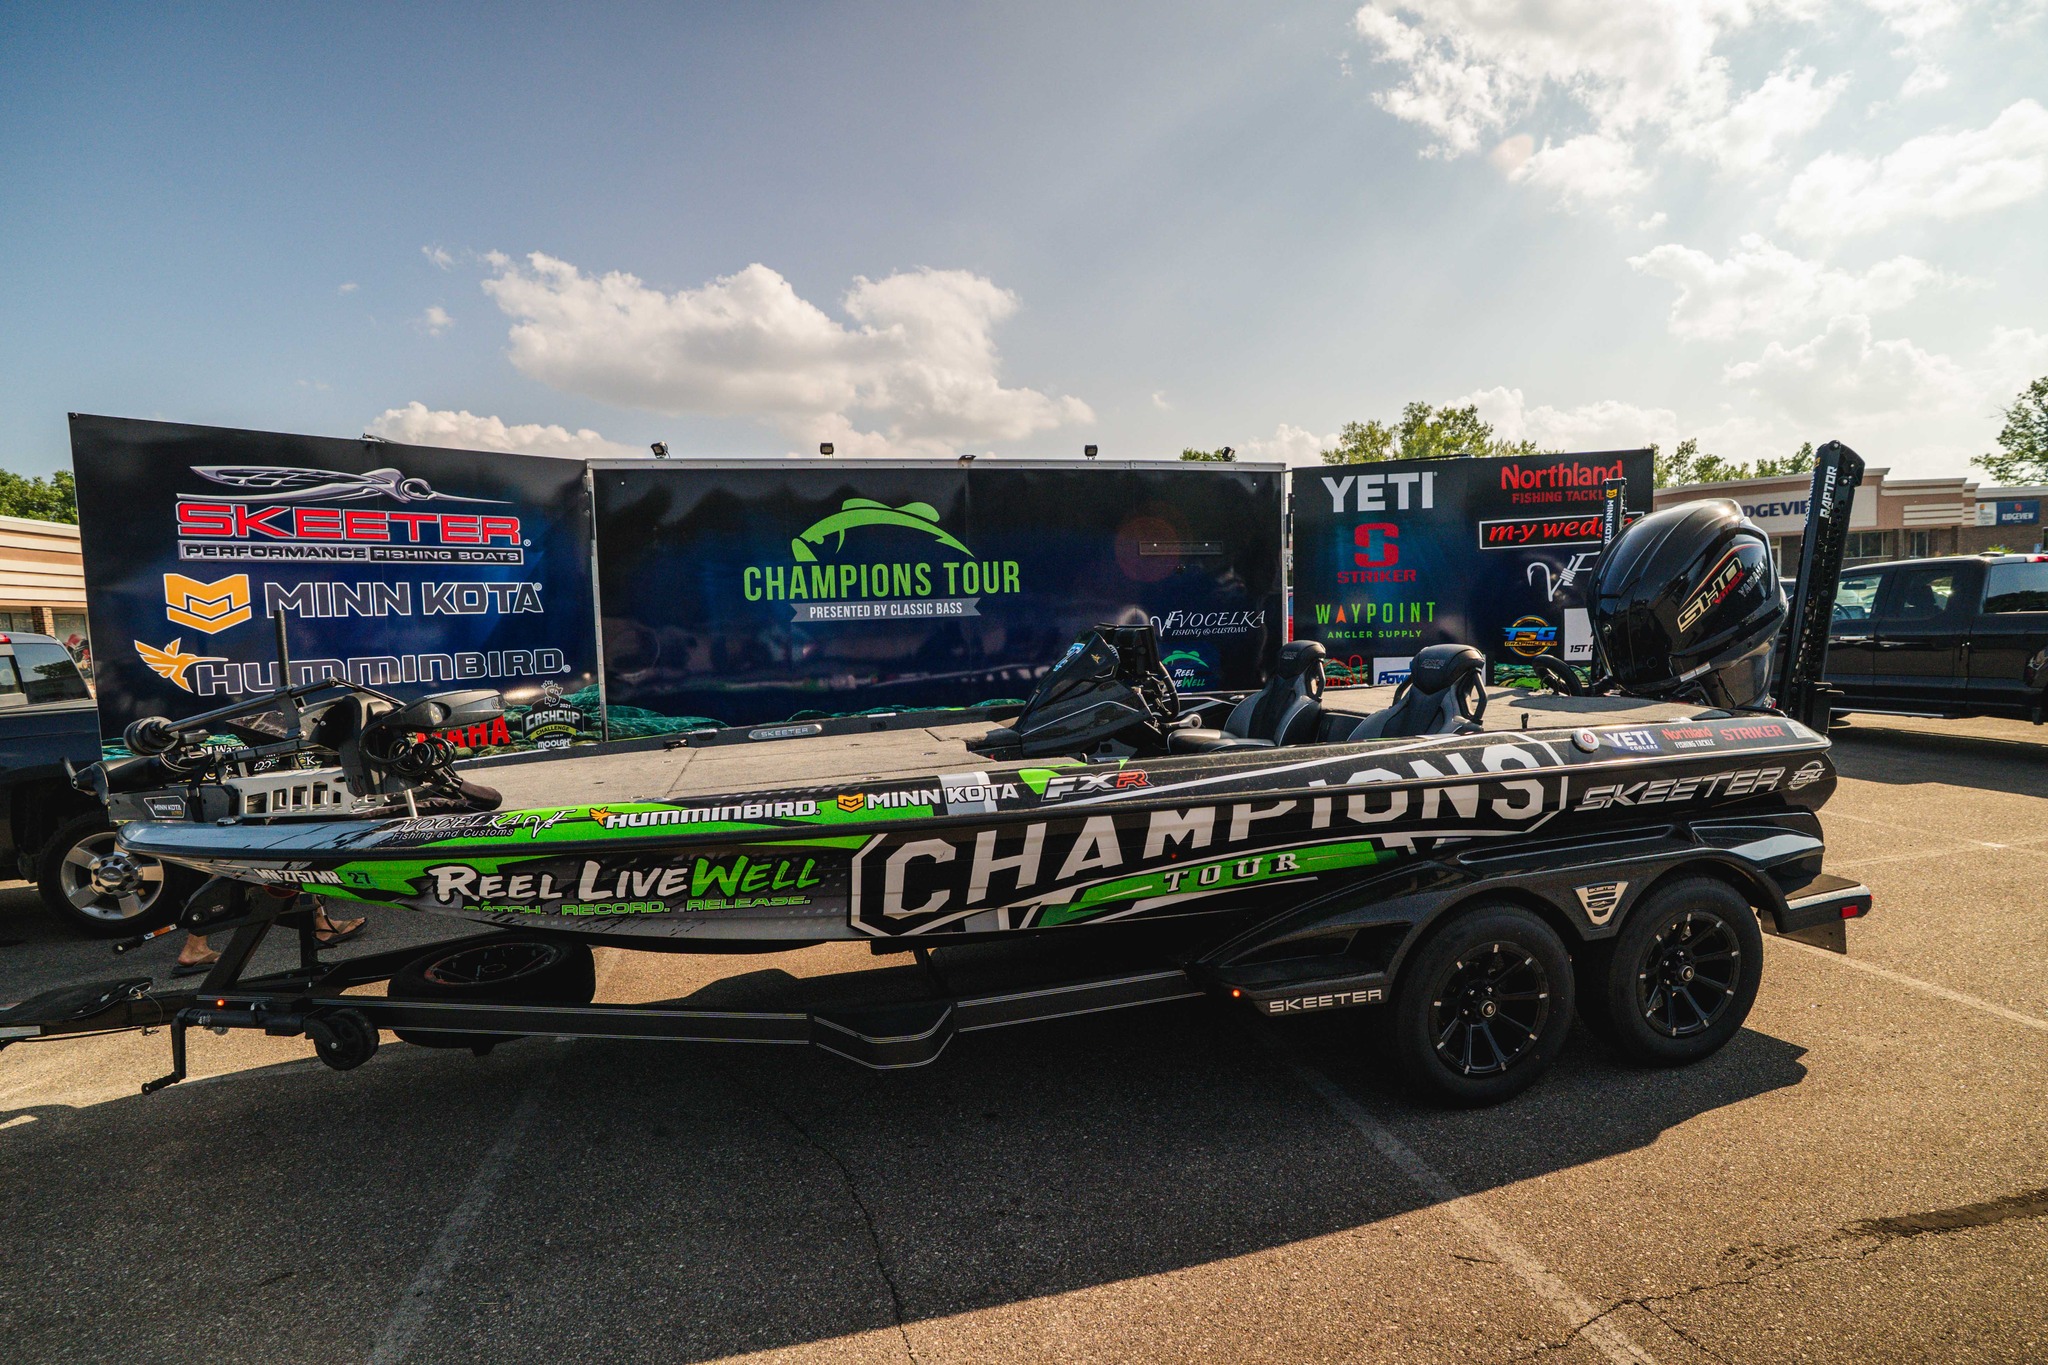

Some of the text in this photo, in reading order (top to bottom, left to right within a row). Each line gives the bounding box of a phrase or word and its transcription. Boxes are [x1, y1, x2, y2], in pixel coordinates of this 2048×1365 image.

[1501, 459, 1623, 490] Northland
[1321, 471, 1434, 513] YETI
[1511, 489, 1604, 504] FISHING TACKL
[1820, 465, 1837, 519] RAPTOR
[175, 500, 521, 546] SKEETER
[2001, 512, 2035, 521] RIDGEVIEW
[184, 545, 520, 562] PERFORMANCE FISHING BOATS
[743, 560, 1021, 602] CHAMPIONS TOUR
[1337, 569, 1417, 584] STRIKER
[1738, 561, 1767, 598] YAMAHA
[264, 582, 544, 619] MINN KOTA
[1677, 557, 1743, 634] SHO
[810, 601, 963, 619] PRESENTED BY CLASSIC BASS
[1177, 610, 1266, 629] VOCELKA
[1315, 602, 1436, 625] WAYPOINT
[1171, 628, 1202, 637] FISHING
[1211, 626, 1248, 635] CUSTOMS
[1327, 629, 1422, 639] ANGLER SUPPLY
[1502, 626, 1558, 642] TSG
[1570, 644, 1588, 653] 1ST
[196, 648, 564, 696] HUMMINBIRD
[1174, 668, 1195, 678] REEL
[525, 709, 581, 731] CASHCUP
[535, 725, 570, 736] CHALLENGE
[760, 727, 808, 737] SKEETER
[1604, 730, 1652, 748] YETI
[1662, 725, 1713, 741] Northland
[1719, 724, 1786, 741] STRIKER
[538, 737, 571, 749] MOOLAH
[1674, 738, 1716, 749] FISHING TACKLE
[1044, 770, 1150, 800] FXR
[1574, 766, 1786, 812] SKEETER
[866, 783, 1019, 810] MINN KOTA
[400, 813, 522, 833] VOCELKA
[605, 800, 818, 829] HUMMINBIRD
[436, 828, 459, 838] and
[463, 827, 514, 838] Customs
[884, 743, 1545, 921] CHAMPIONS
[347, 872, 371, 884] 27
[427, 865, 563, 902] REEL
[1164, 853, 1301, 894] TOUR
[561, 901, 671, 916] RECORD.
[685, 896, 811, 912] RELEASE.
[1269, 989, 1382, 1013] SKEETER
